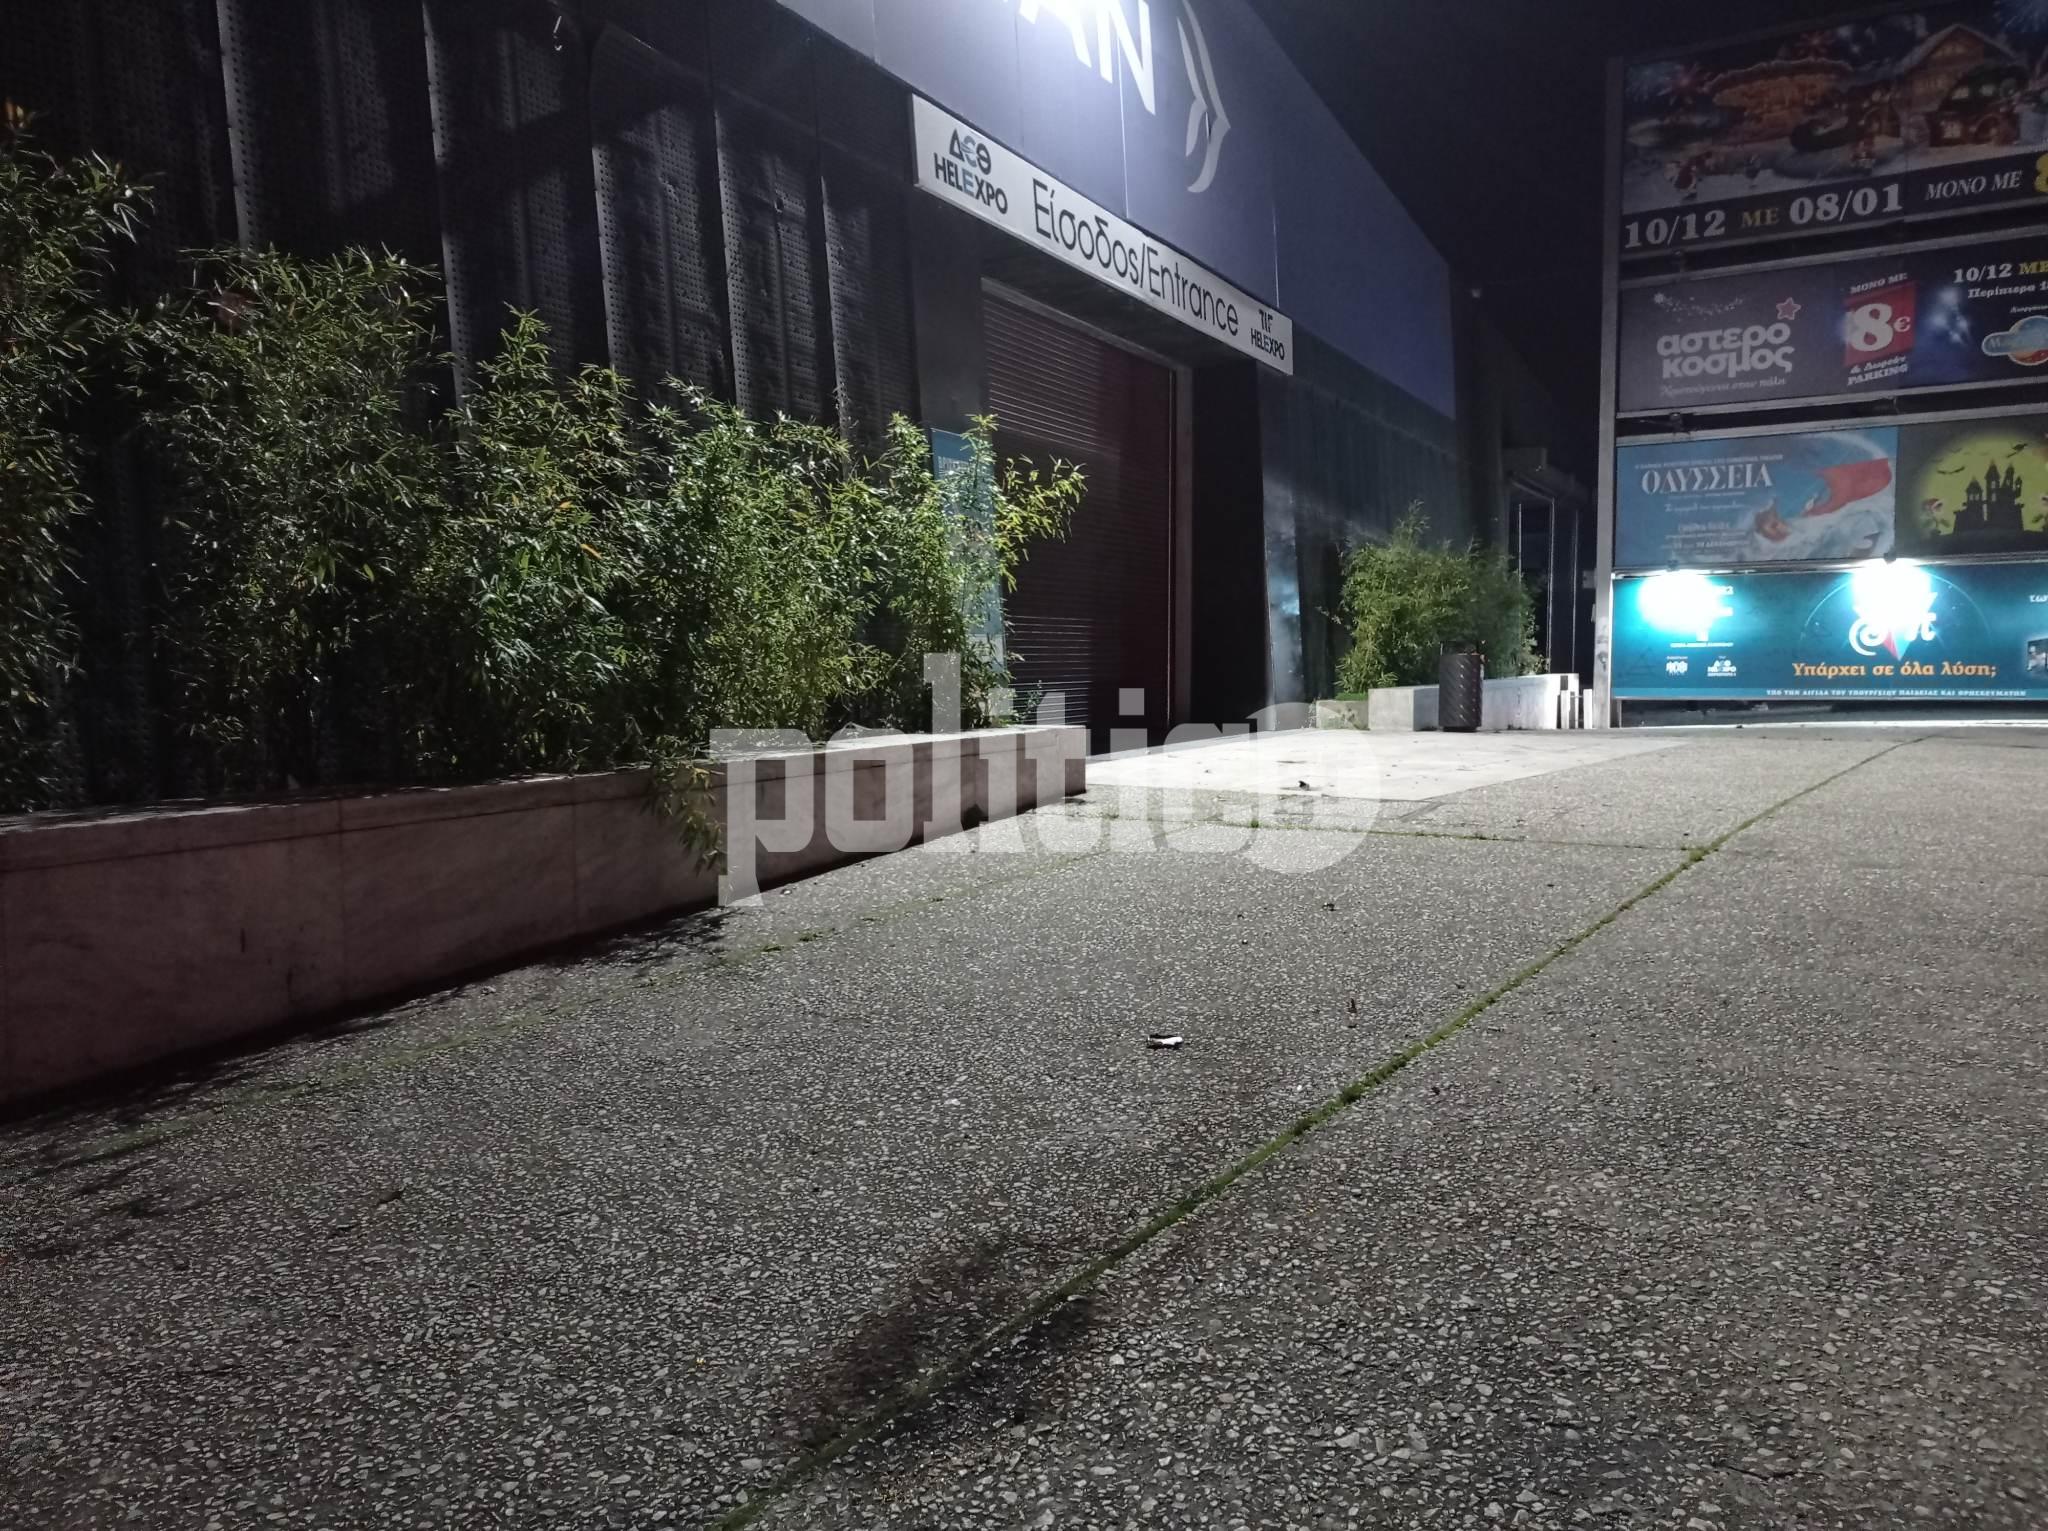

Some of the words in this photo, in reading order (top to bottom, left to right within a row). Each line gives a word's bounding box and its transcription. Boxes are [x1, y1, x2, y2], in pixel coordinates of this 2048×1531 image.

[933, 151, 1009, 215] HELEXPO
[1624, 209, 1727, 249] 10/12
[1789, 184, 1904, 225] 08/01
[1953, 263, 2013, 284] 10/12
[1250, 327, 1286, 361] HELEXPO
[1641, 462, 1774, 496] ΟΔΥΣΣΕΙΑ
[1791, 661, 1866, 679] Υπάρχει
[1872, 664, 1894, 676] σε
[1900, 661, 1934, 676] όλα
